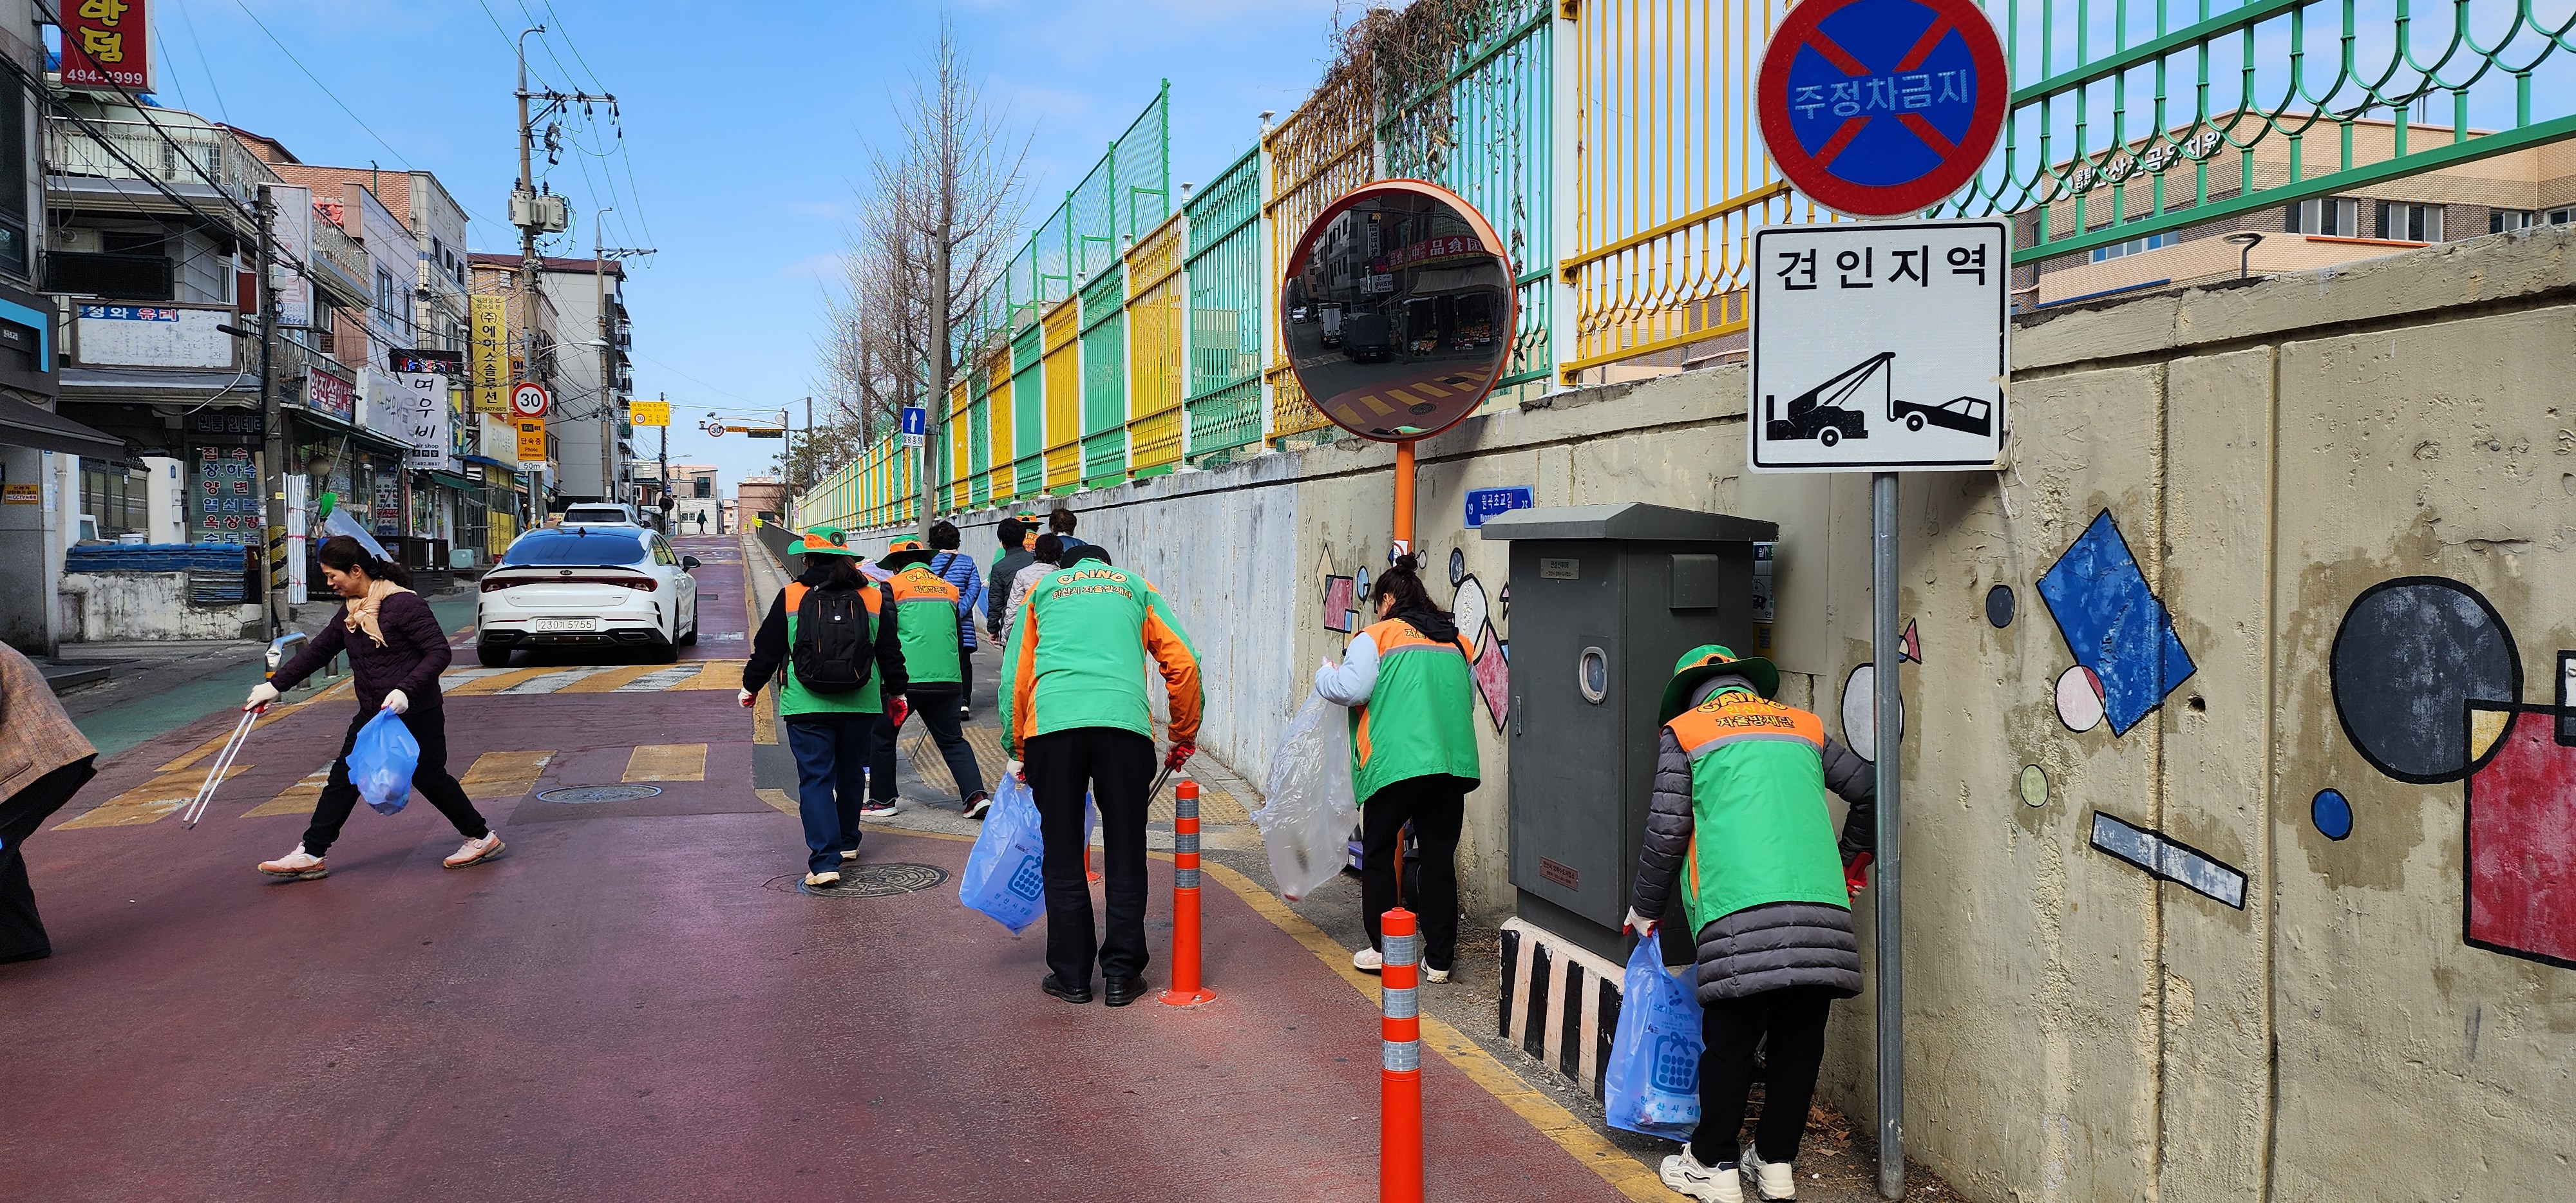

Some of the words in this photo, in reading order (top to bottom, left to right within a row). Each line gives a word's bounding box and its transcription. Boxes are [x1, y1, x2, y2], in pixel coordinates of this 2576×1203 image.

[1795, 68, 1969, 119] 주정차금지
[1776, 243, 1987, 291] 견인지역
[137, 307, 178, 321] 유리
[311, 372, 344, 410] 영진설비
[414, 377, 436, 439] 여우비
[520, 393, 540, 408] 30
[198, 414, 223, 432] 원룸
[1481, 492, 1513, 510] 원곡초교길
[1468, 503, 1473, 515] 19
[905, 570, 945, 584] CAIND
[1056, 569, 1128, 585] CAIND
[1052, 586, 1081, 600] 안산시
[1083, 585, 1133, 600] 자율방재단
[568, 620, 592, 629] 5755
[1696, 692, 1788, 713] CAIND
[1724, 704, 1774, 715] 안산시
[1715, 714, 1795, 728] 자율방재단
